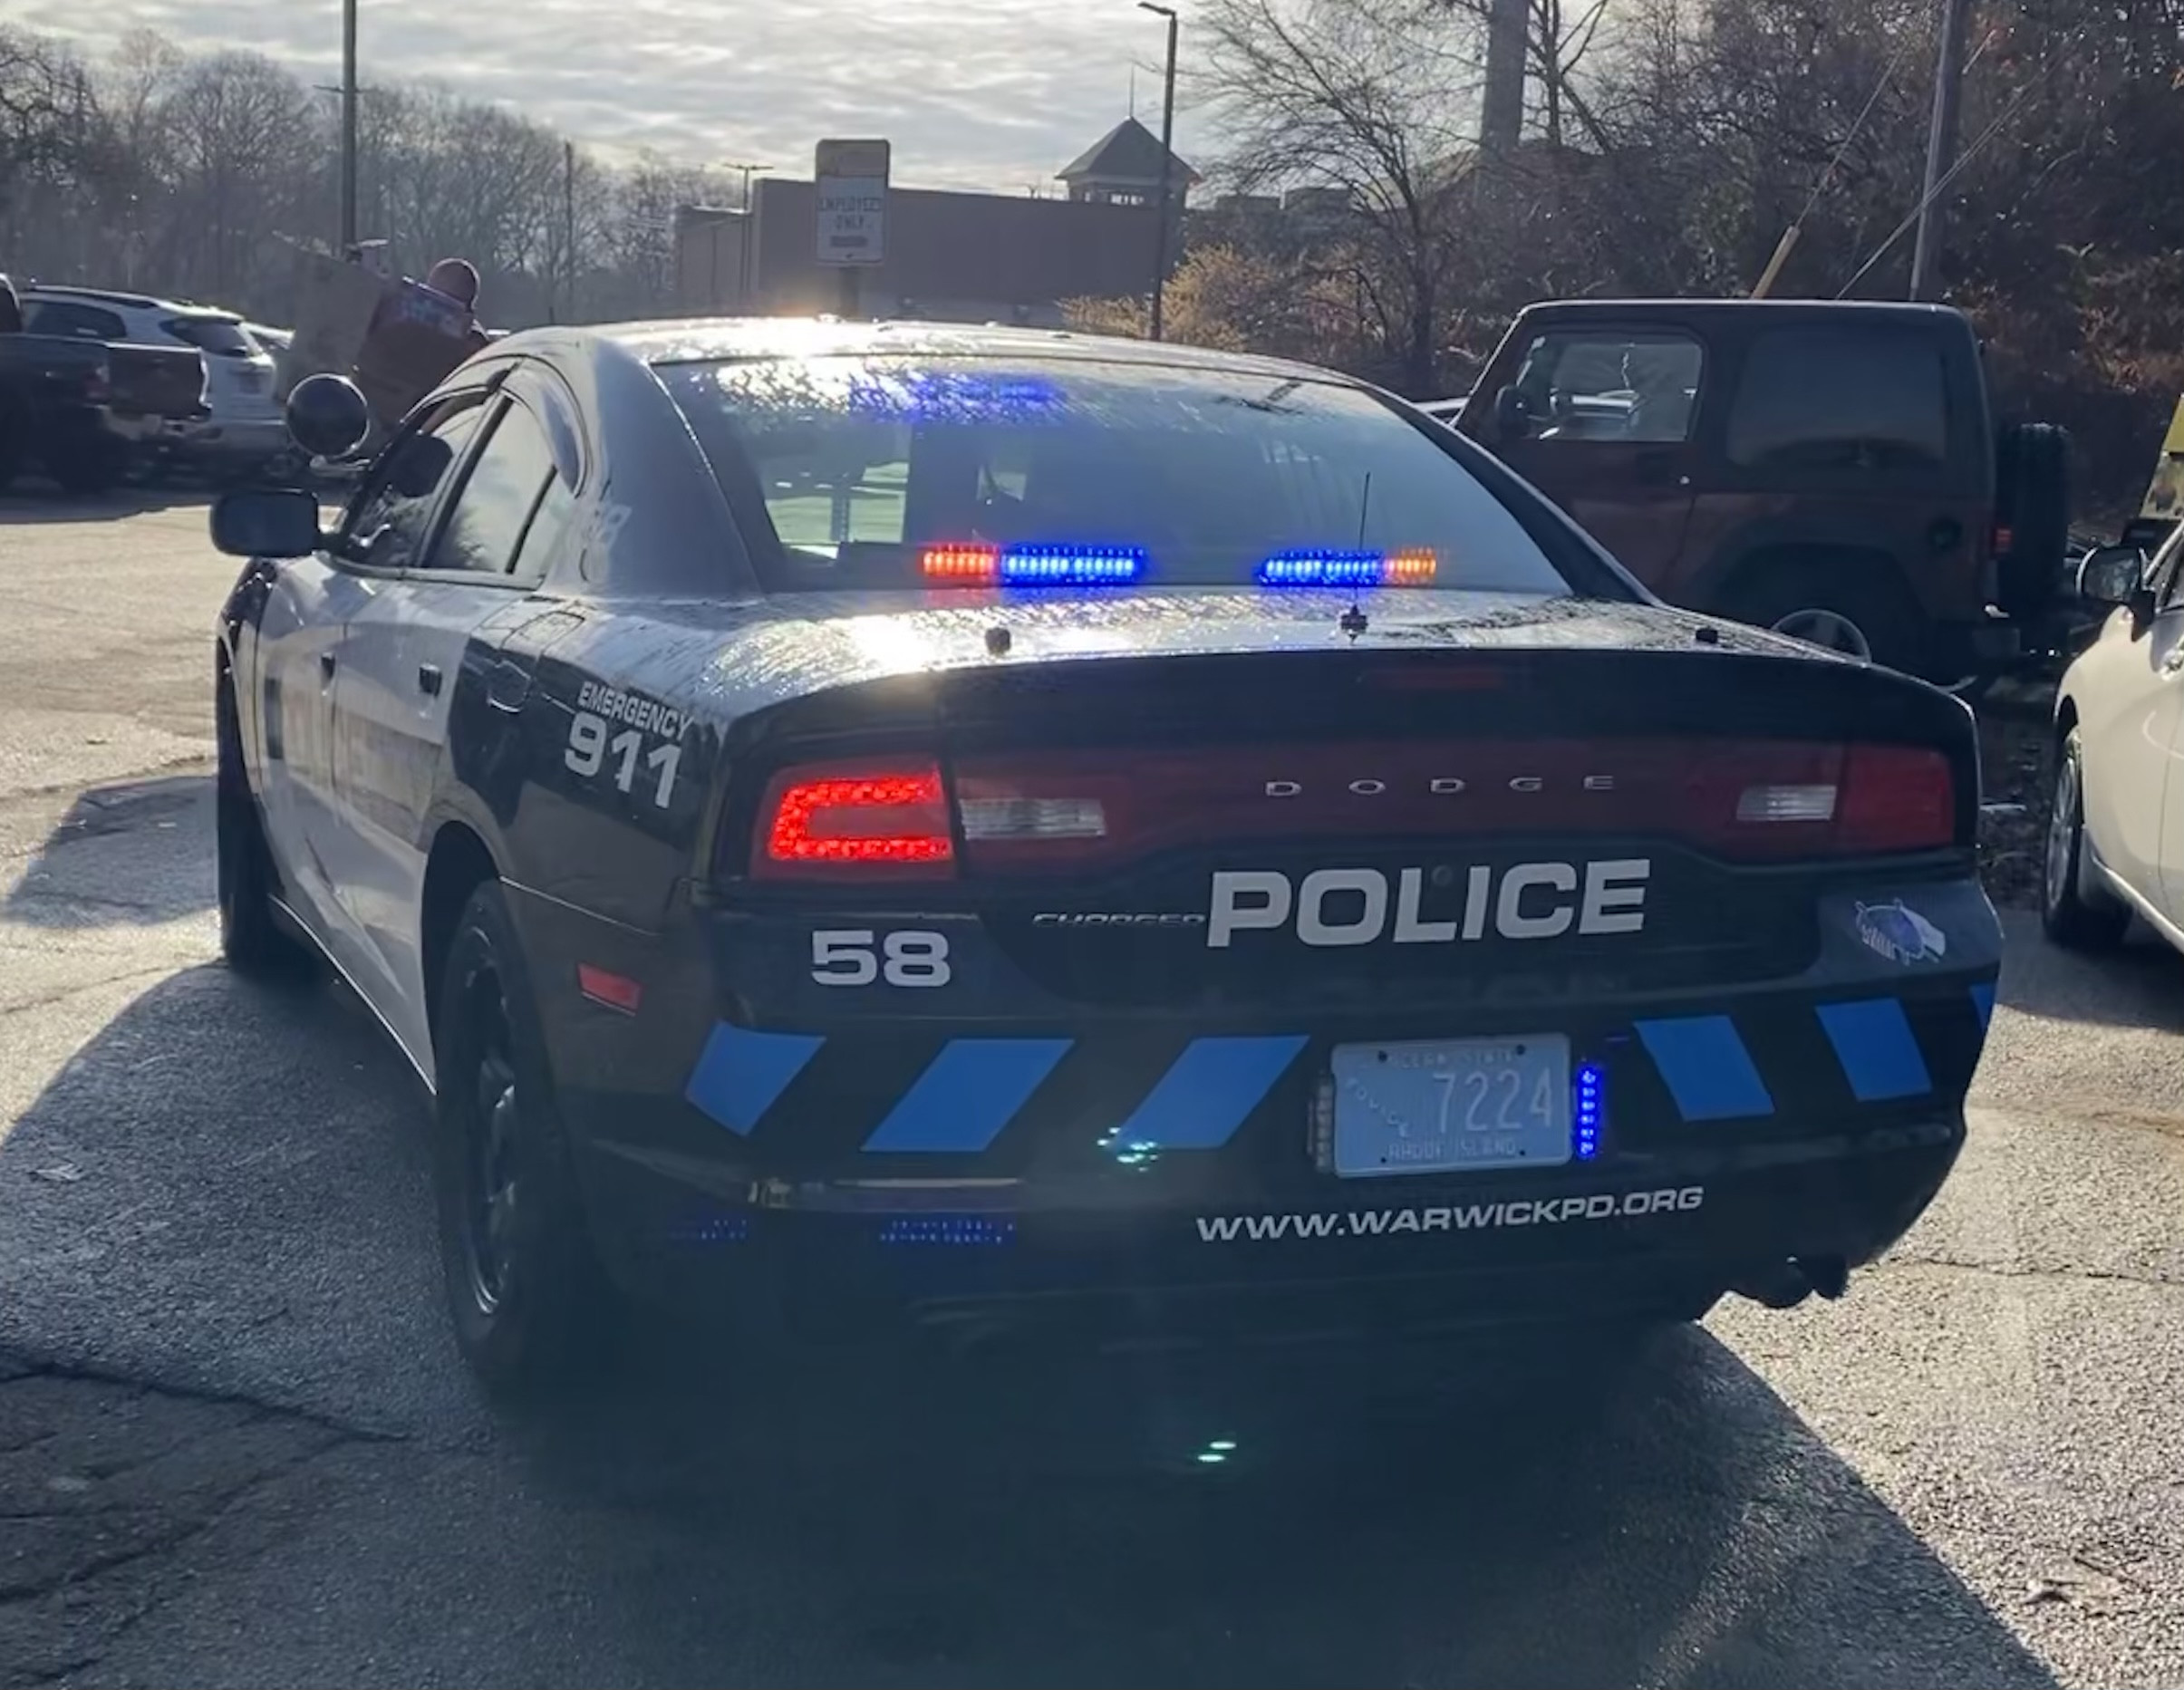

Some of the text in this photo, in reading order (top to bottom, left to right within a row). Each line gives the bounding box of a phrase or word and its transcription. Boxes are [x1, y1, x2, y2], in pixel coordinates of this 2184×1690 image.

[577, 681, 694, 741] EMERGENCY
[565, 710, 681, 808] 911
[1266, 775, 1614, 797] DODGE
[1207, 859, 1650, 947] POLICE
[811, 930, 951, 987] 58
[1433, 1067, 1552, 1134] 7224
[1196, 1187, 1704, 1241] WWW.WARWICKPD.ORG
